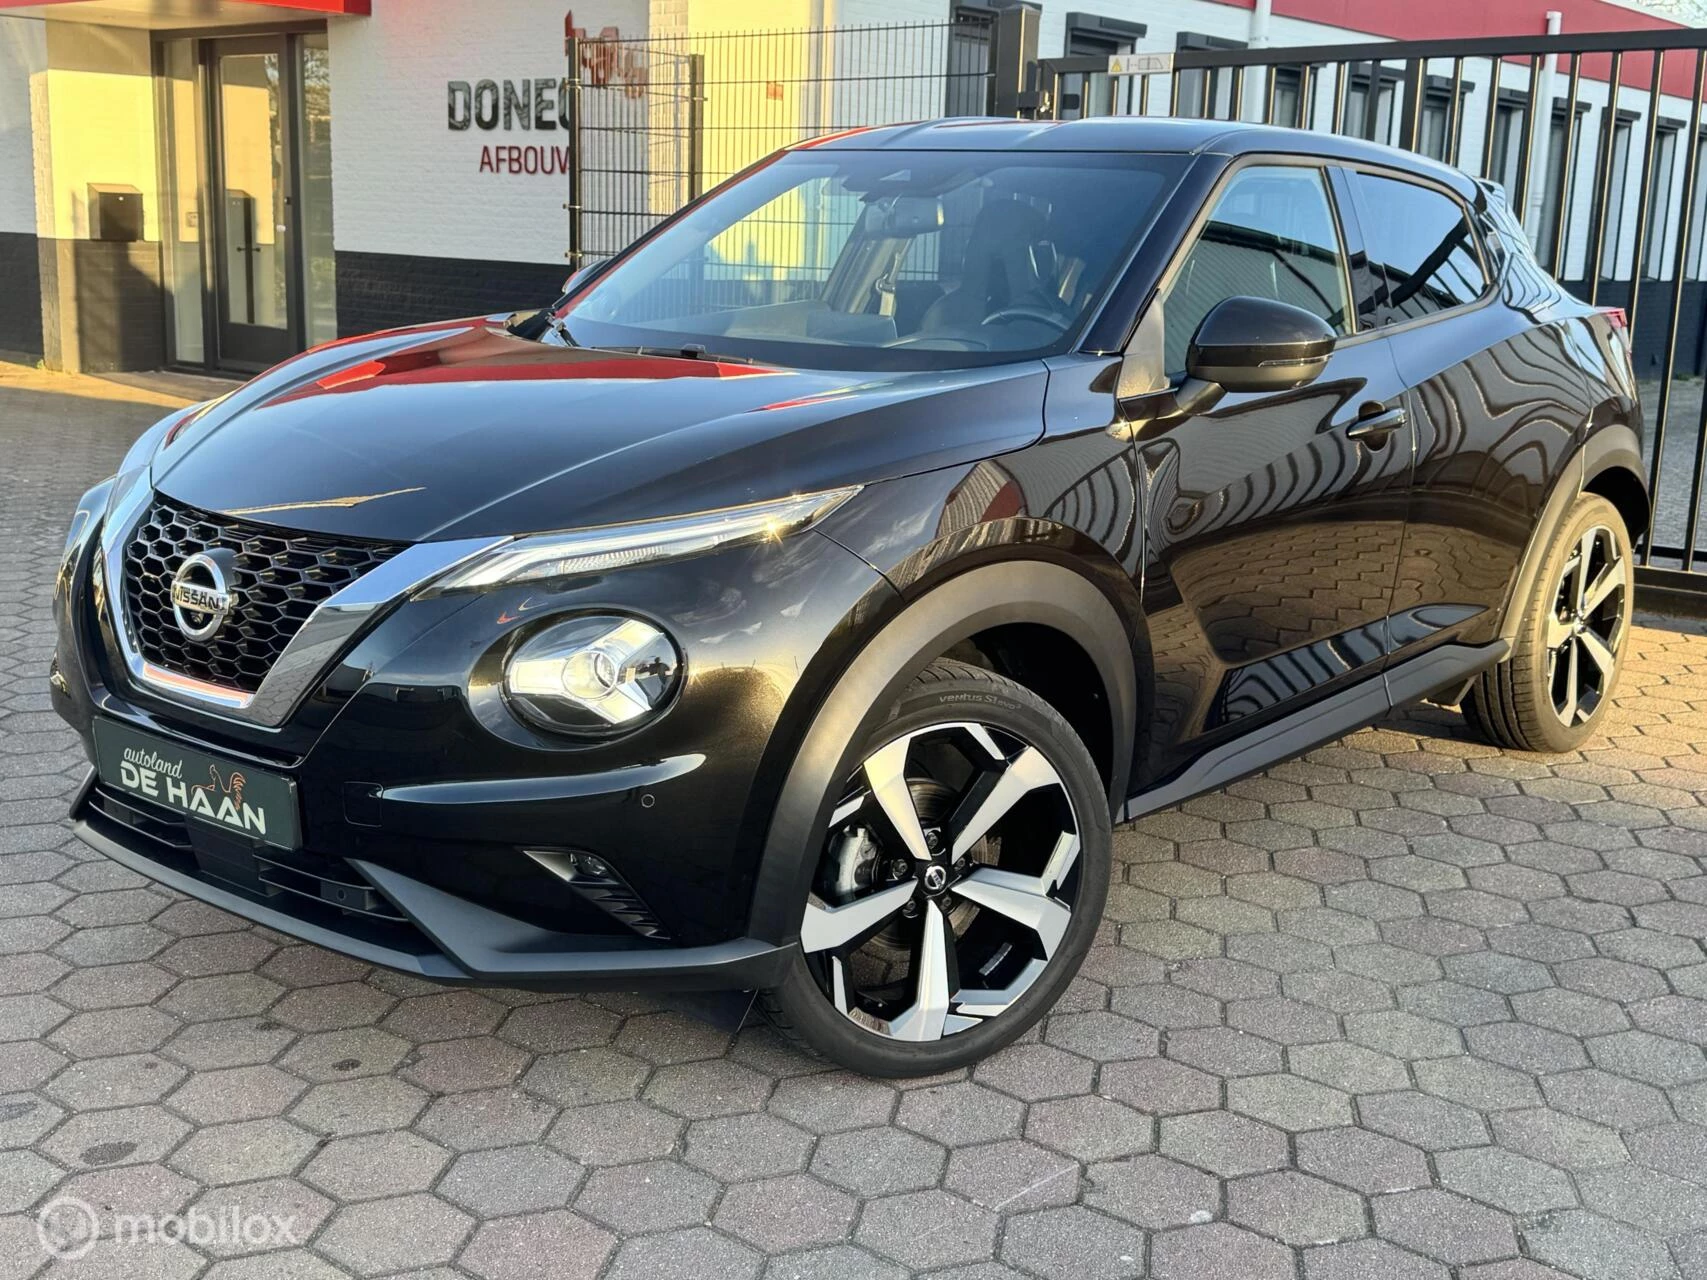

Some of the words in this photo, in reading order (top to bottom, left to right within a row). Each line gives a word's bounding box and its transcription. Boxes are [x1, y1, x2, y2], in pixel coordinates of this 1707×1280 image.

[173, 584, 219, 610] NISSAN
[123, 747, 183, 779] autoland
[120, 760, 159, 798] DE
[166, 776, 267, 836] HAAN
